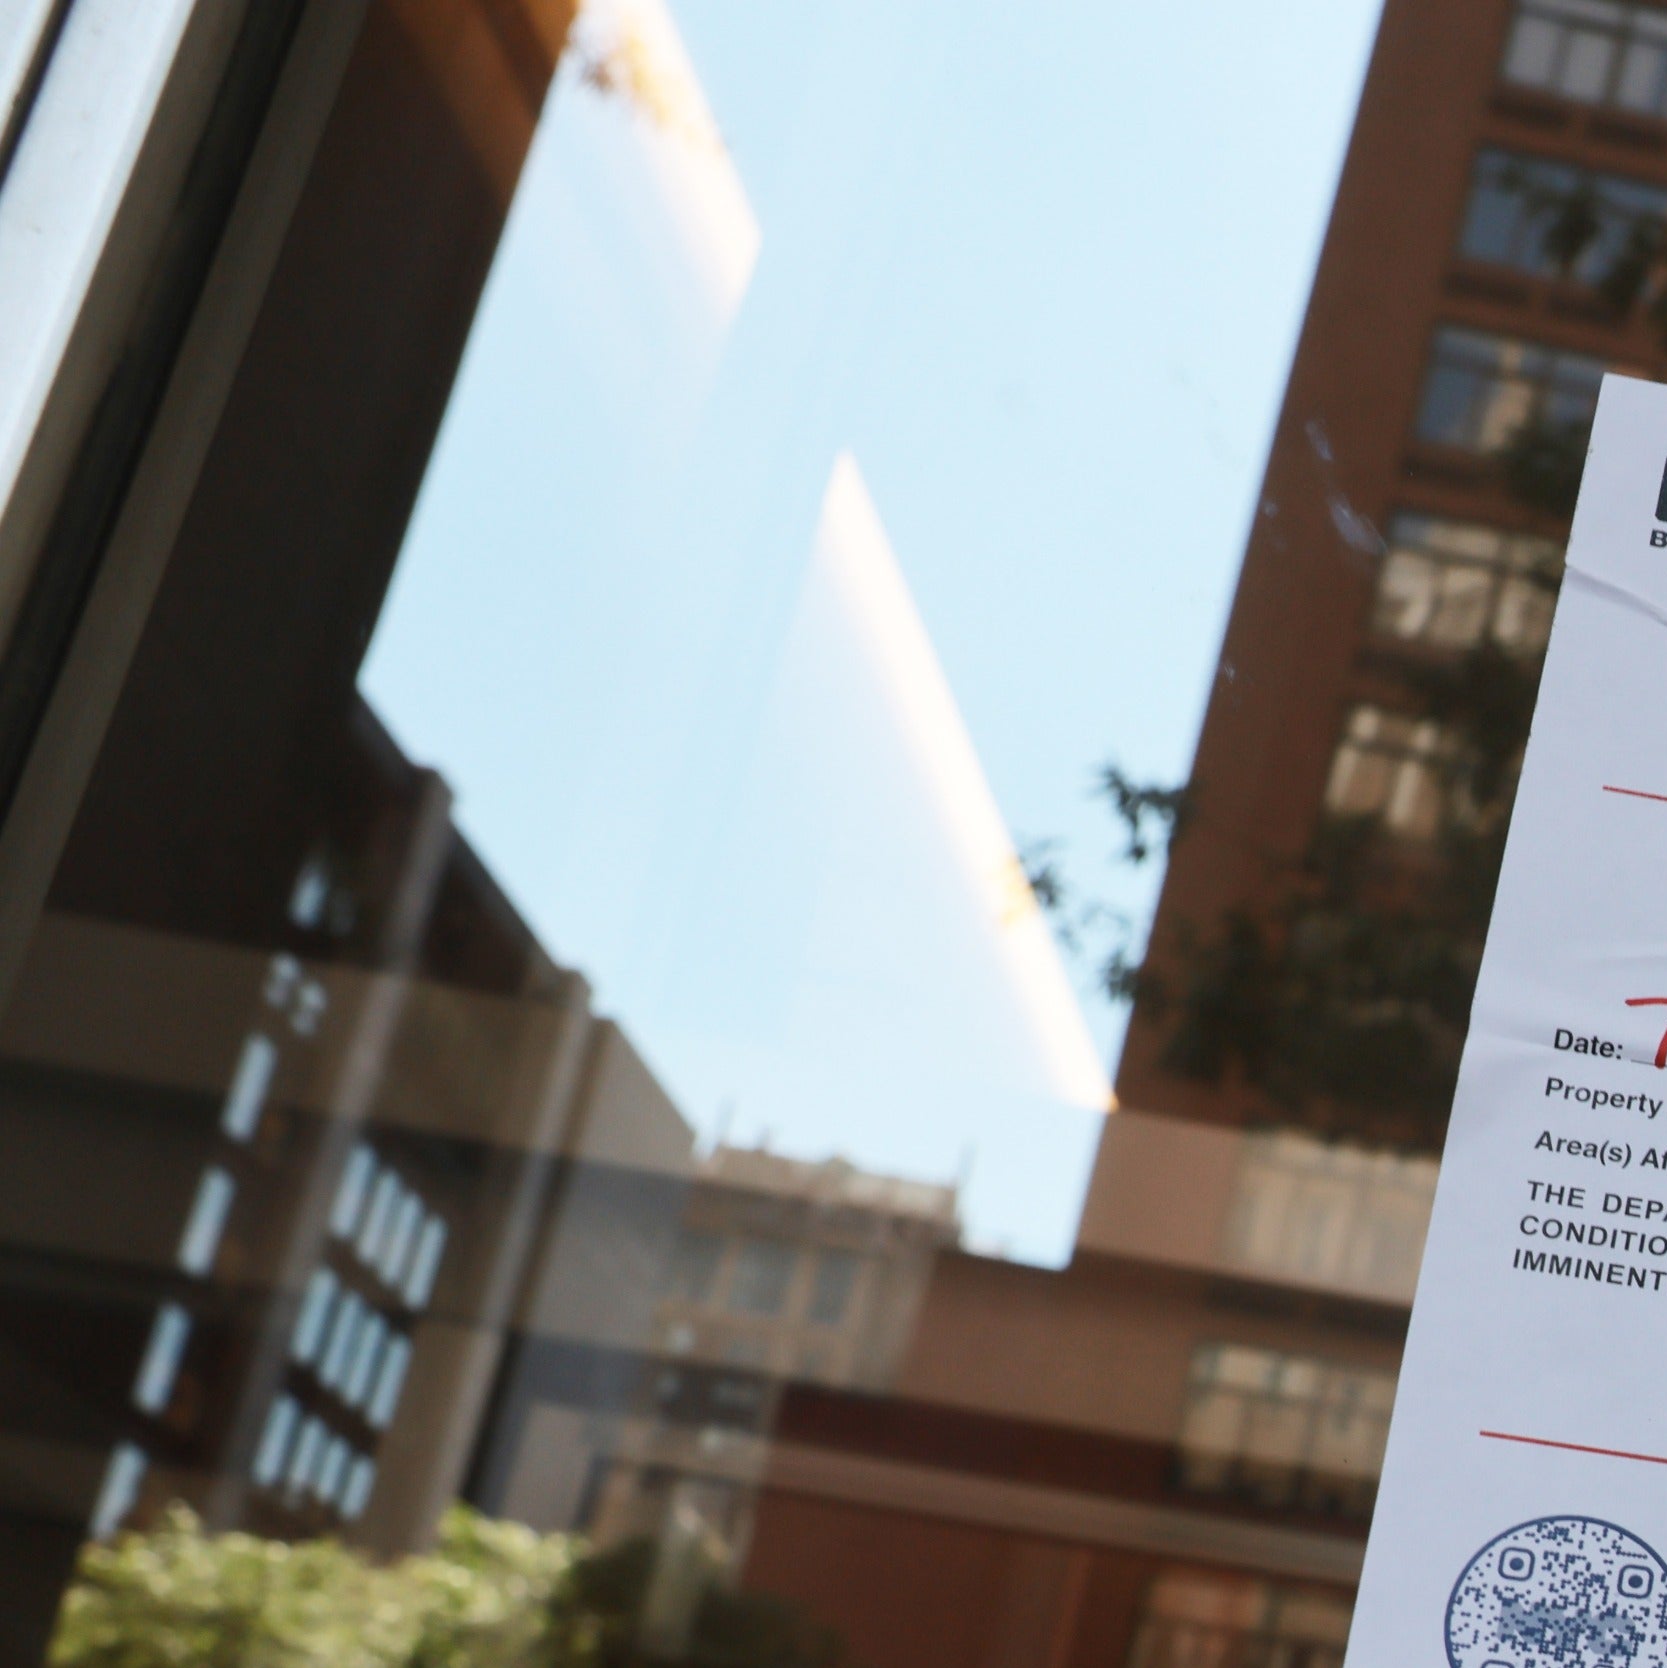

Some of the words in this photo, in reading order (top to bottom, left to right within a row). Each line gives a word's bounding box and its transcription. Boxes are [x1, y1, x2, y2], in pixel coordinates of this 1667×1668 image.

[1554, 1028, 1623, 1060] Date:
[1545, 1077, 1663, 1119] Property
[1535, 1131, 1631, 1168] Area(s)
[1528, 1181, 1585, 1208] THE
